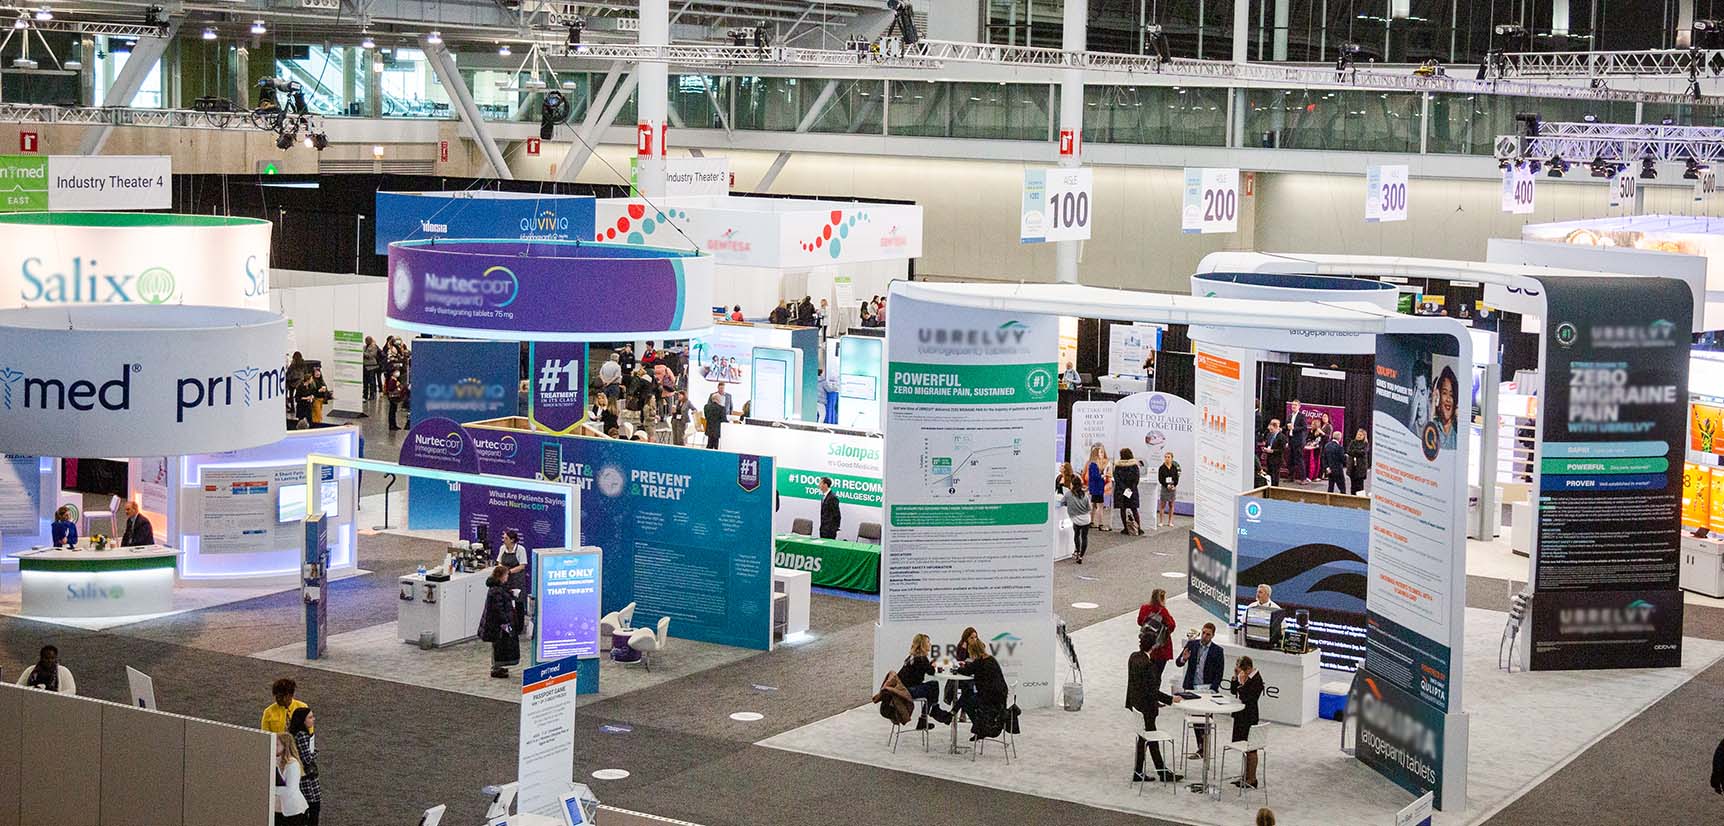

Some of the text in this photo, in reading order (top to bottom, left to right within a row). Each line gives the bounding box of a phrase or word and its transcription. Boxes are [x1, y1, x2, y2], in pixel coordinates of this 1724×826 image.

[57, 175, 163, 191] Industry Theater 4
[666, 171, 726, 184] Industry Theater 3
[1702, 173, 1716, 193] 600
[1515, 180, 1533, 205] 400
[1619, 176, 1635, 198] 500
[8, 197, 30, 205] EAST
[1204, 189, 1235, 221] 200
[1381, 183, 1405, 211] 300
[1050, 191, 1089, 228] 100
[519, 216, 569, 232] QUVIVIQ
[20, 255, 135, 303] Salix
[425, 272, 476, 294] Nurtec
[539, 359, 579, 392] #1
[894, 372, 962, 386] POWERFUL
[1033, 376, 1045, 387] #1
[1569, 369, 1629, 386] ZERO
[540, 391, 578, 399] TREATMENT
[893, 385, 1015, 397] ZERO MIGRAINE PAIN, SUSTAINED
[1569, 385, 1677, 404] MIGRAINE
[1122, 411, 1144, 420] DON'T
[1568, 404, 1619, 421] PAIN
[1122, 419, 1135, 427] DO
[1146, 421, 1193, 432] TOGETHER
[415, 434, 460, 448] Nurtec ODT
[500, 442, 515, 451] ODT
[828, 442, 880, 461] Salonpas
[740, 459, 757, 476] #1
[837, 460, 853, 468] Good
[631, 469, 691, 488] PREVENT
[788, 474, 799, 483] #1
[800, 475, 841, 488] DOCOR
[488, 498, 508, 507] About
[509, 501, 531, 510] Nurtec
[489, 490, 566, 507] What Are Patients Saying
[836, 490, 875, 502] ANALGESIC
[548, 568, 594, 579] THE ONLY
[1421, 679, 1446, 701] QULIPTA
[1360, 728, 1437, 786] (atogepant) tablets
